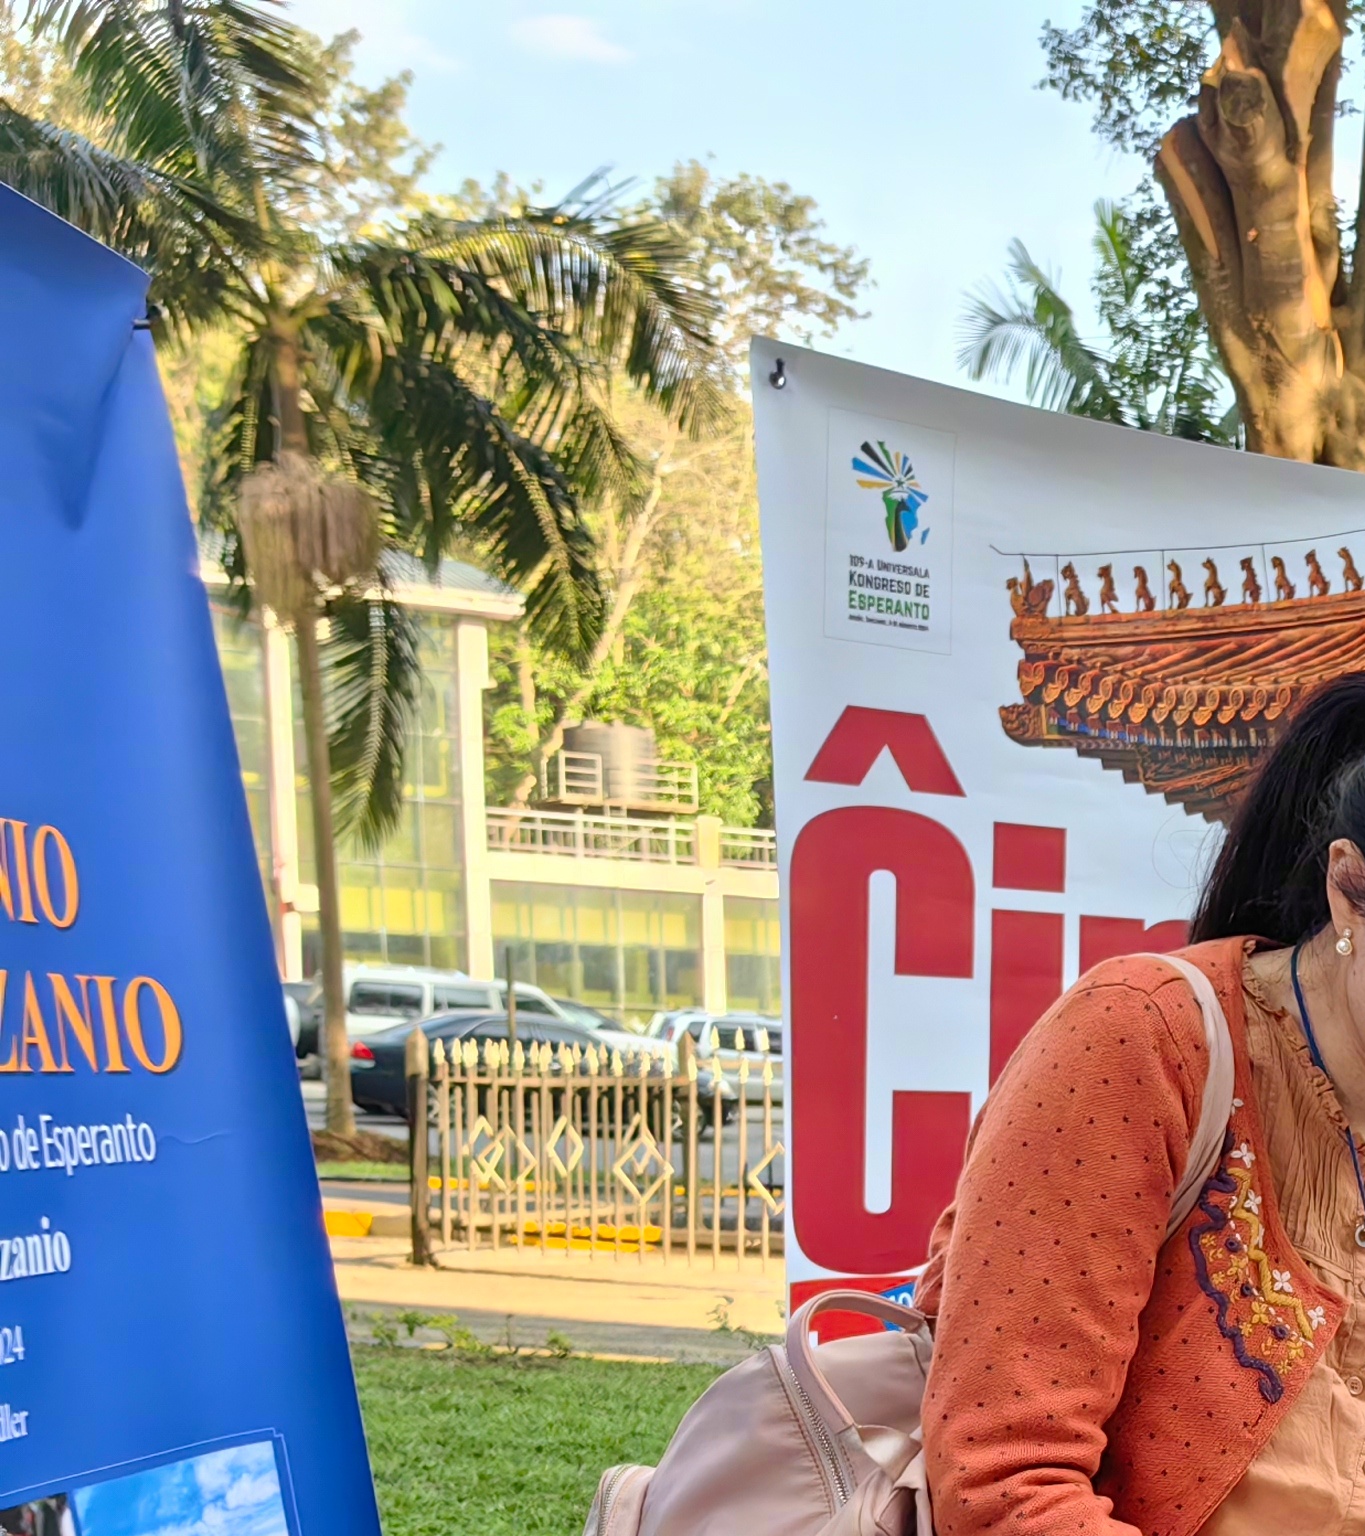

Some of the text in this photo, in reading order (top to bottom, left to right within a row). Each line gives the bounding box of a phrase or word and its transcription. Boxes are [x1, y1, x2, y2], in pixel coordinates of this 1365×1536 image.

[848, 570, 930, 599] KONGRESO DE
[848, 589, 930, 620] ESPERANTO
[13, 1114, 40, 1171] de
[39, 1113, 156, 1176] Esperanto
